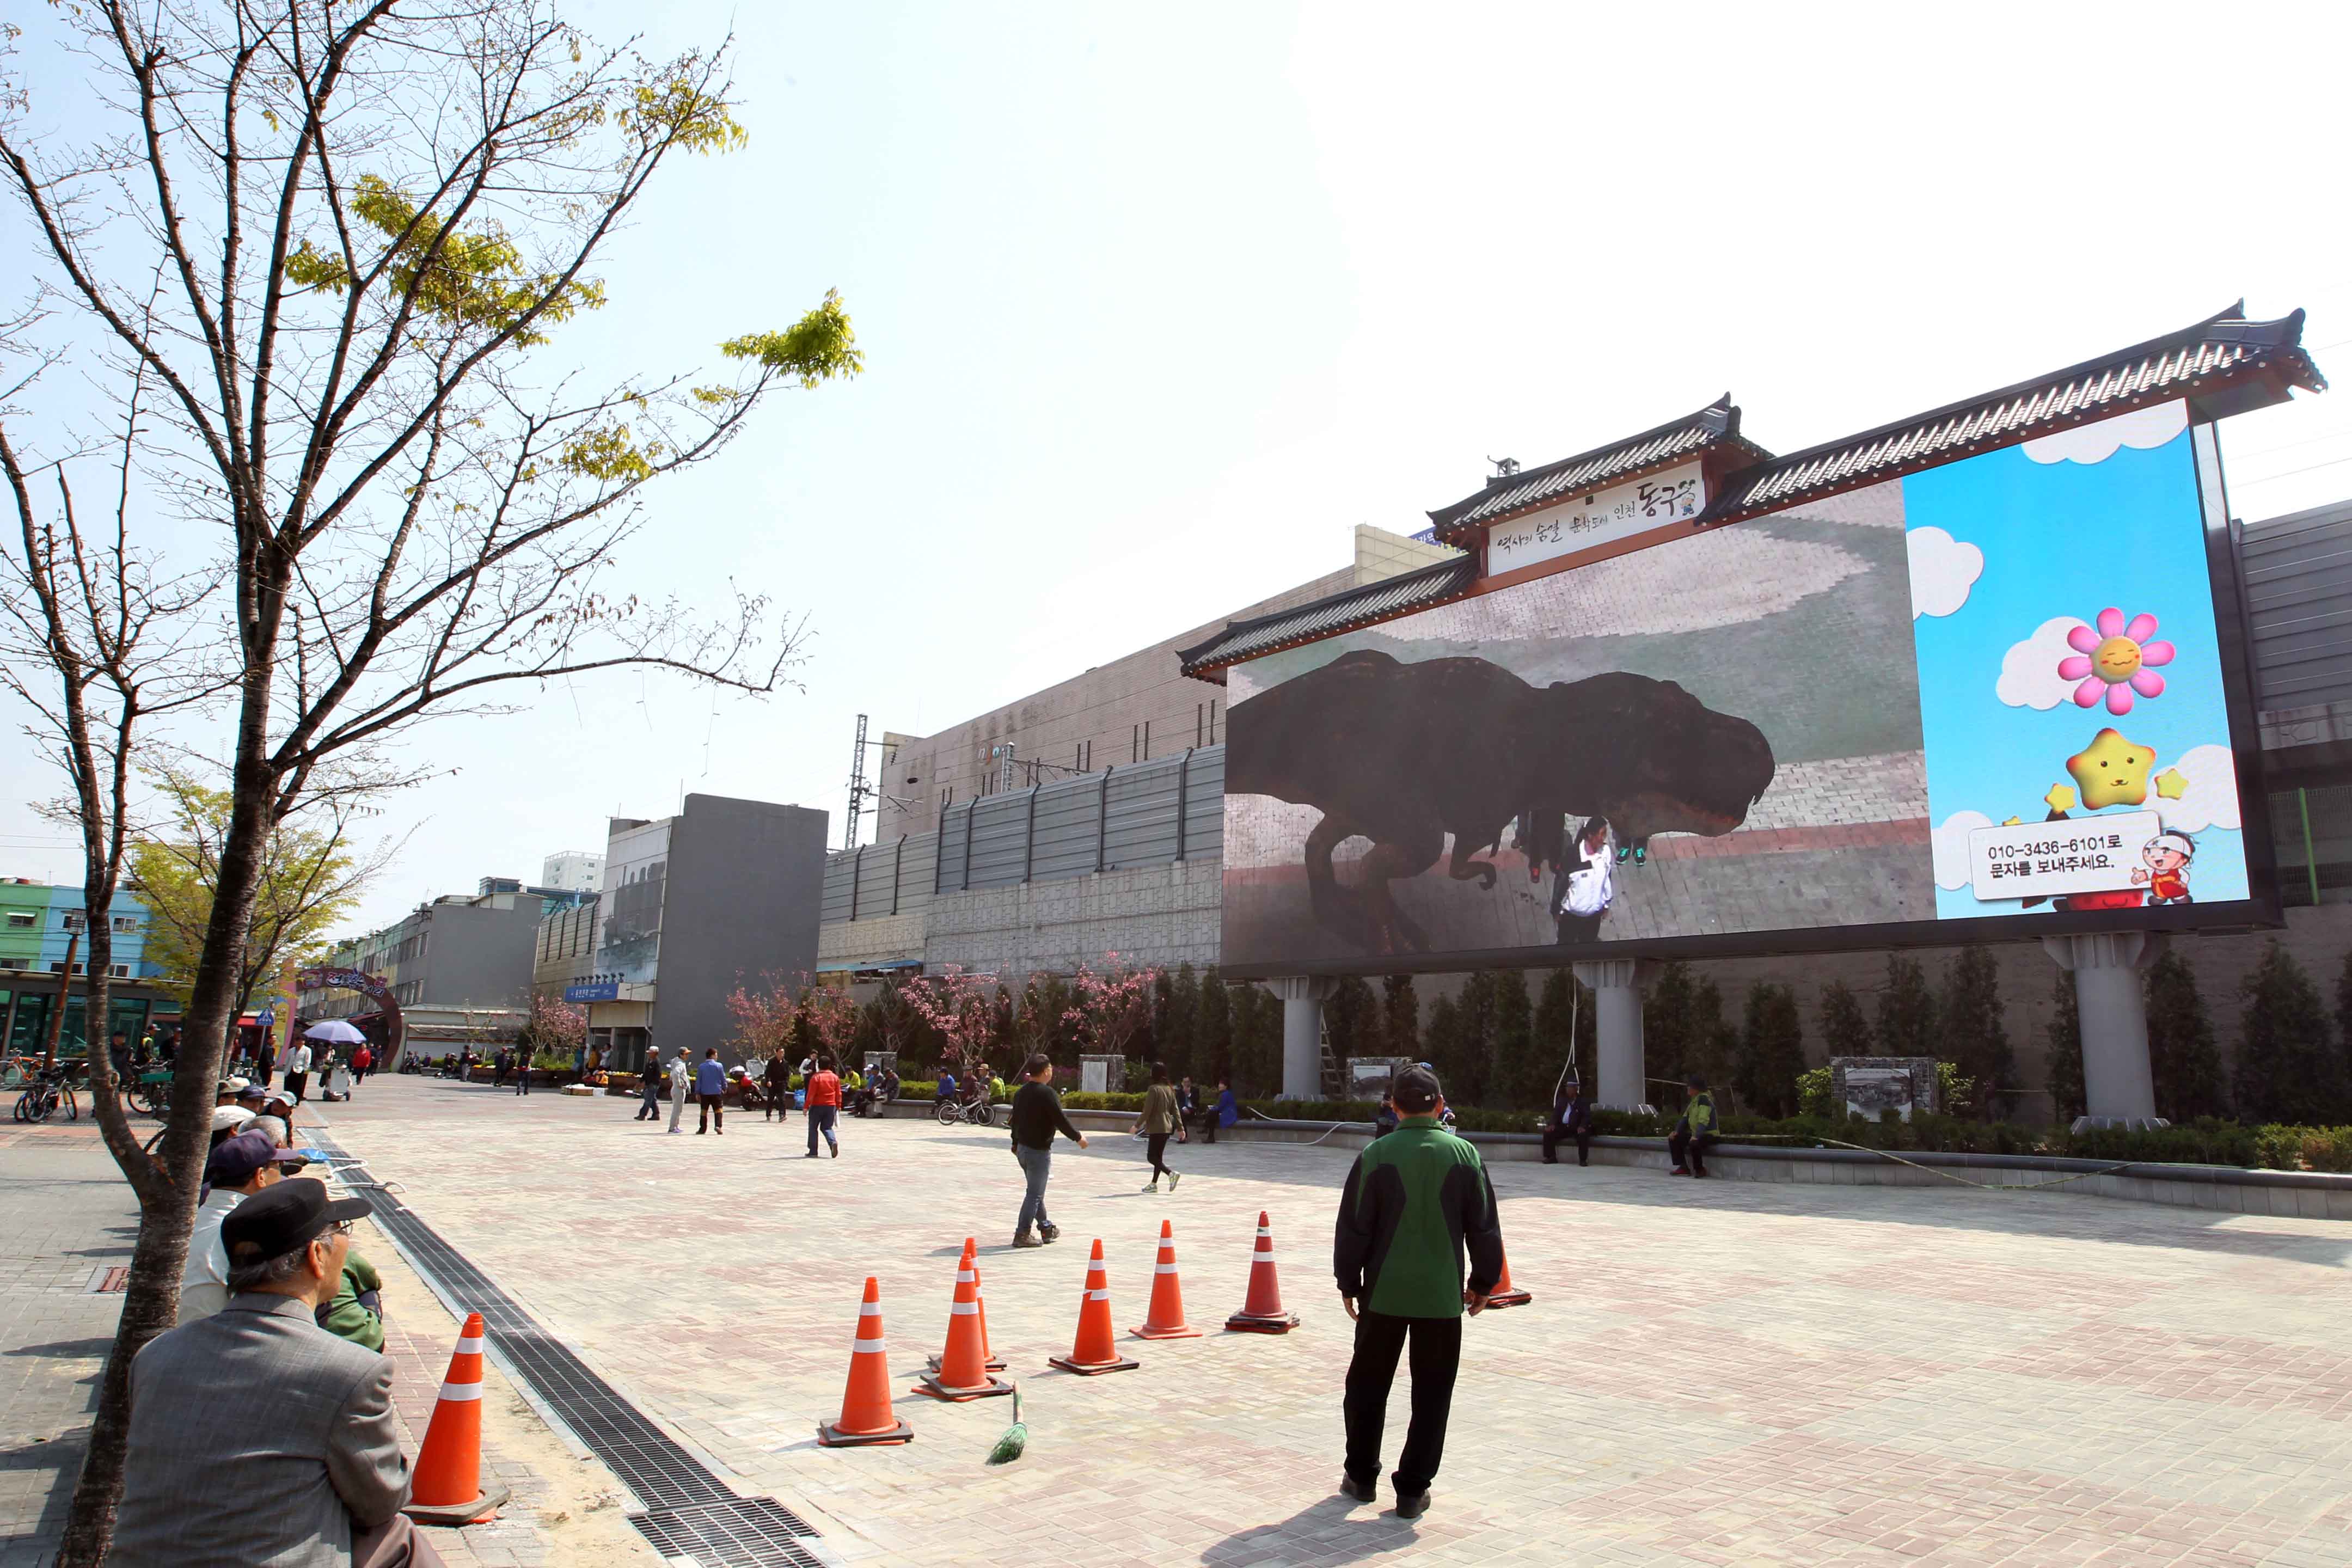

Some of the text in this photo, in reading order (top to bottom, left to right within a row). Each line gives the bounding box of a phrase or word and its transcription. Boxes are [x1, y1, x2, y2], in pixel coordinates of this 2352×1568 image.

[1497, 482, 1689, 555] 역사의 숨결 문화도시 인천 동구
[1988, 834, 2123, 860] 010-3436-6101로
[1990, 854, 2115, 879] 문자를 보내주세요.
